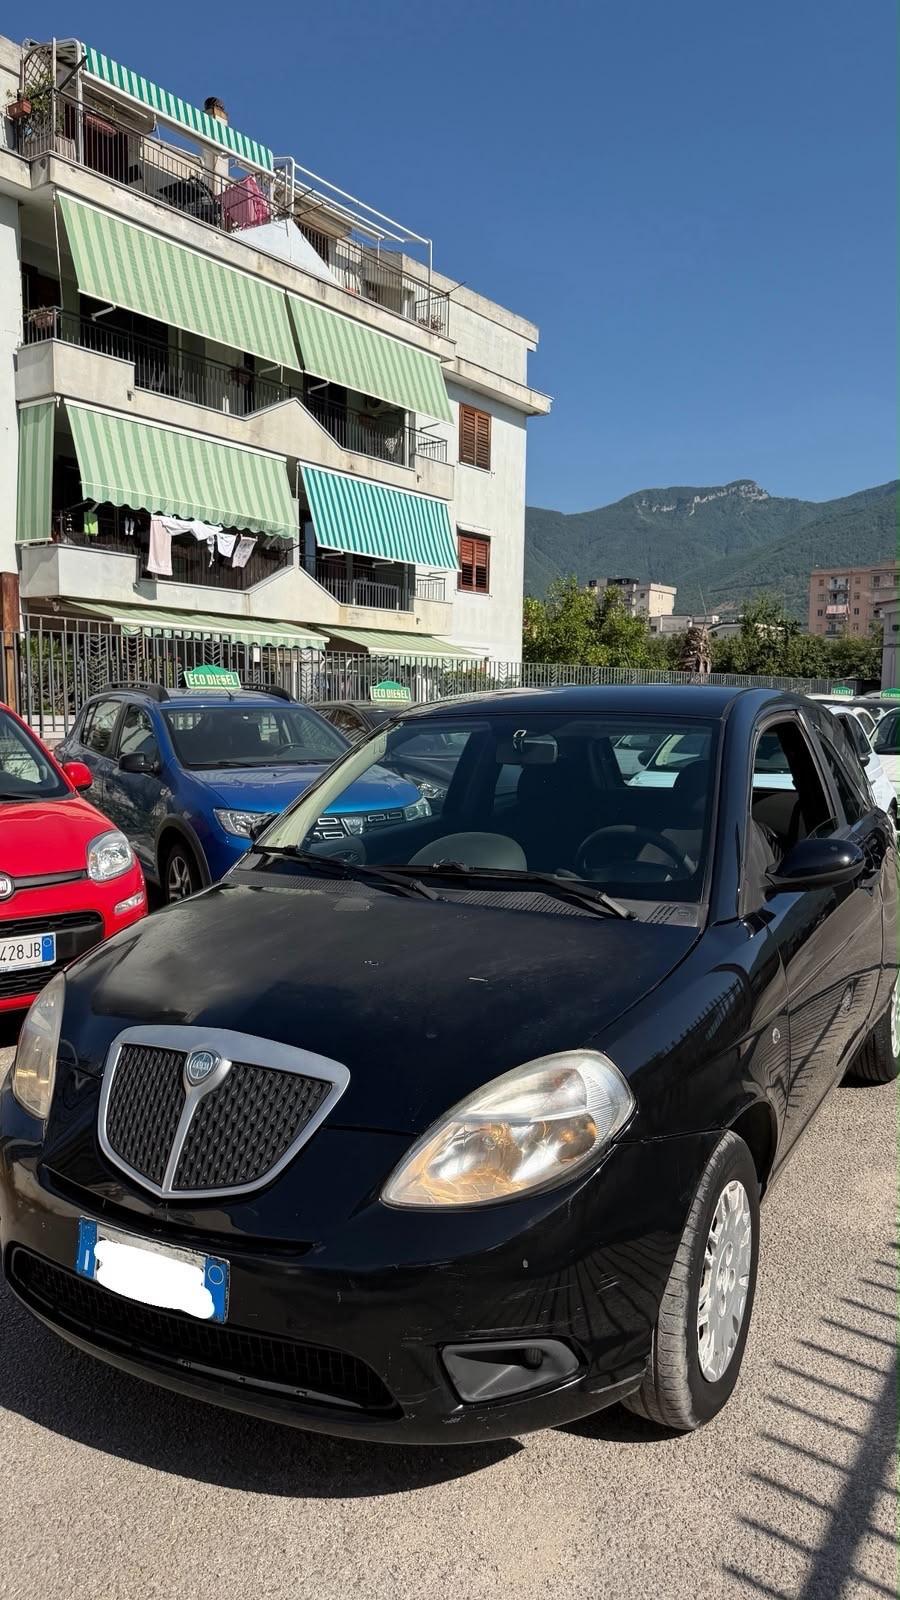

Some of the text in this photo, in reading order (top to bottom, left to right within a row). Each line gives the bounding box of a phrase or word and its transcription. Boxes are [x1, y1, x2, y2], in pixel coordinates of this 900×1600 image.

[188, 674, 237, 685] ECO DIESEL
[373, 689, 409, 699] ECO DIESEL
[0, 942, 41, 963] 428JB
